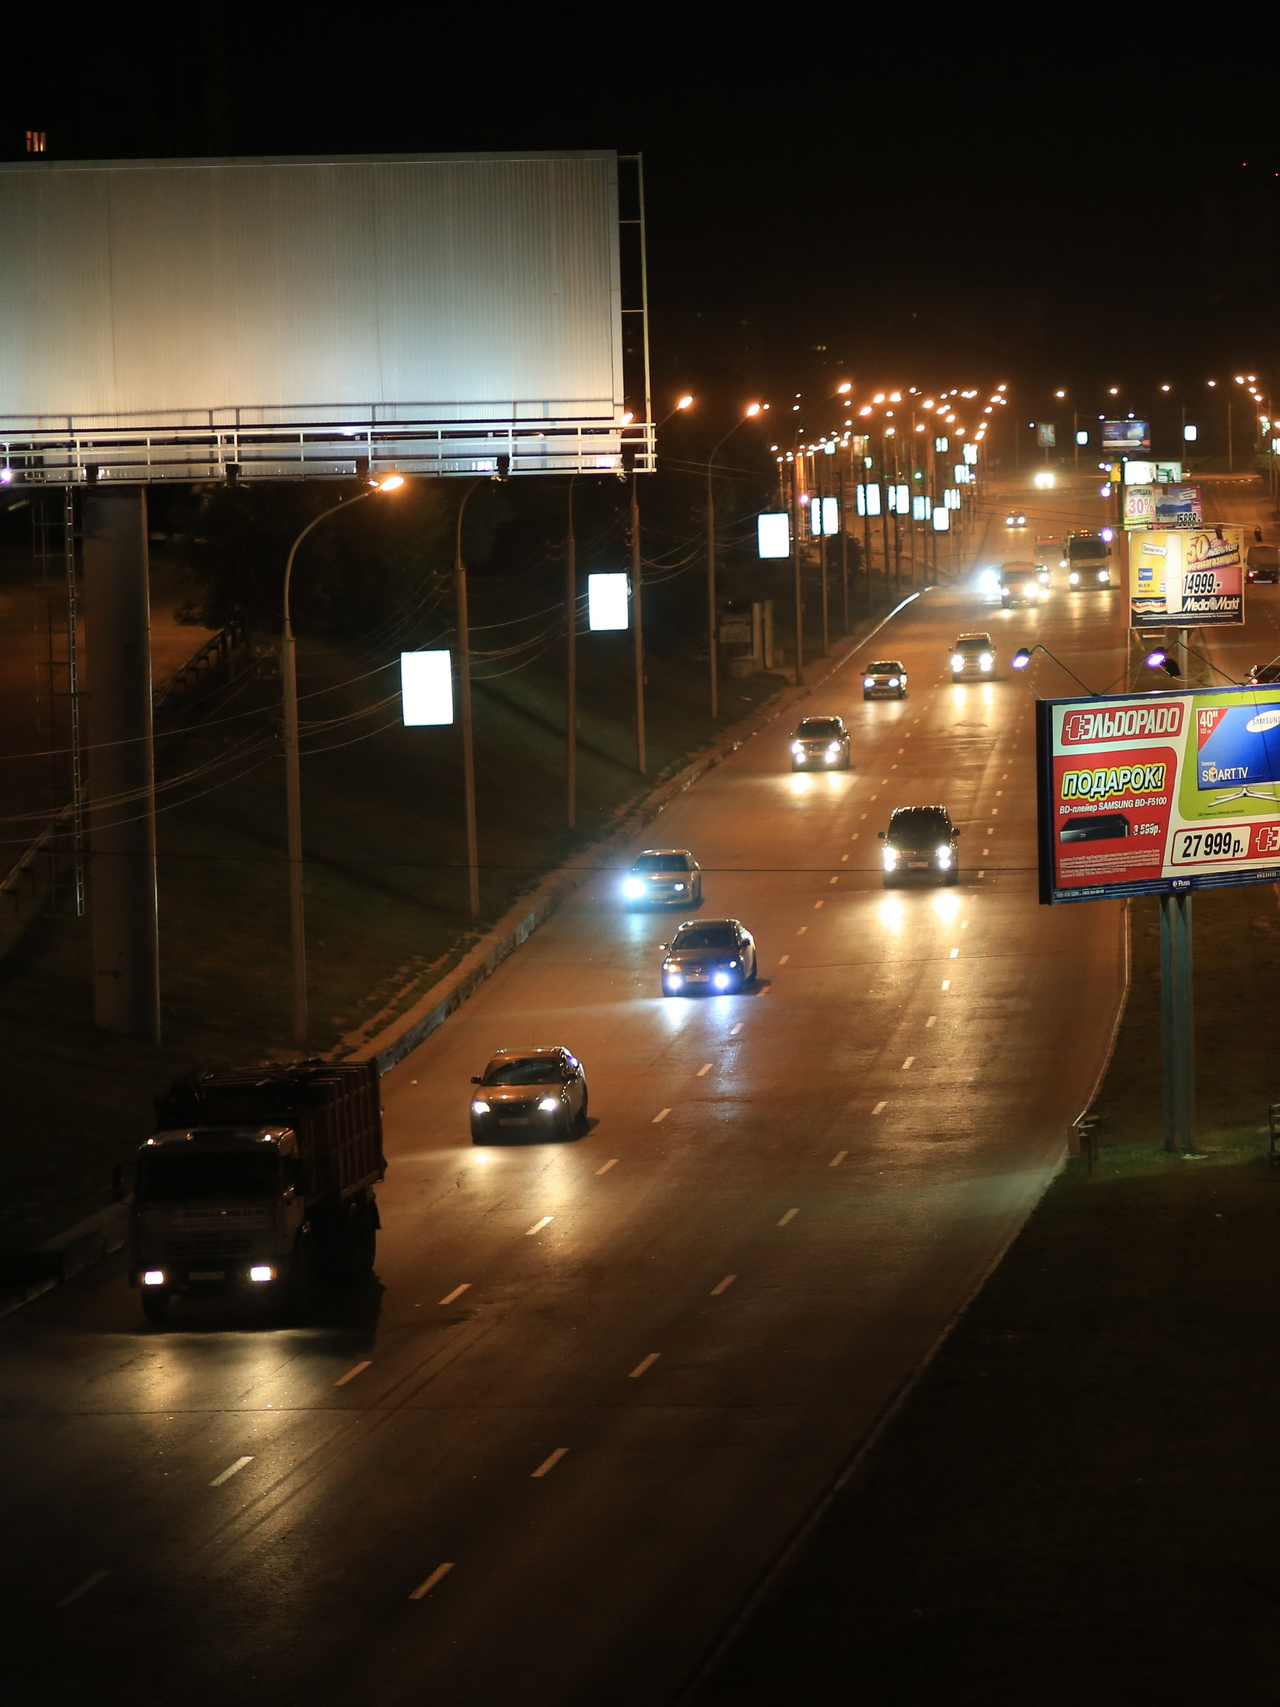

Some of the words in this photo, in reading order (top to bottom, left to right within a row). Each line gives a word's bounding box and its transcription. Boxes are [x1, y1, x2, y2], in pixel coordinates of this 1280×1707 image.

[1129, 498, 1155, 515] 30%
[1187, 535, 1210, 563] 50
[1063, 765, 1166, 798] ПОДАРОК!
[1237, 766, 1249, 780] TV
[1098, 799, 1134, 811] SAMSUNG
[1135, 796, 1167, 808] BD-F5100
[1182, 834, 1202, 858] 27
[1204, 832, 1232, 857] 999
